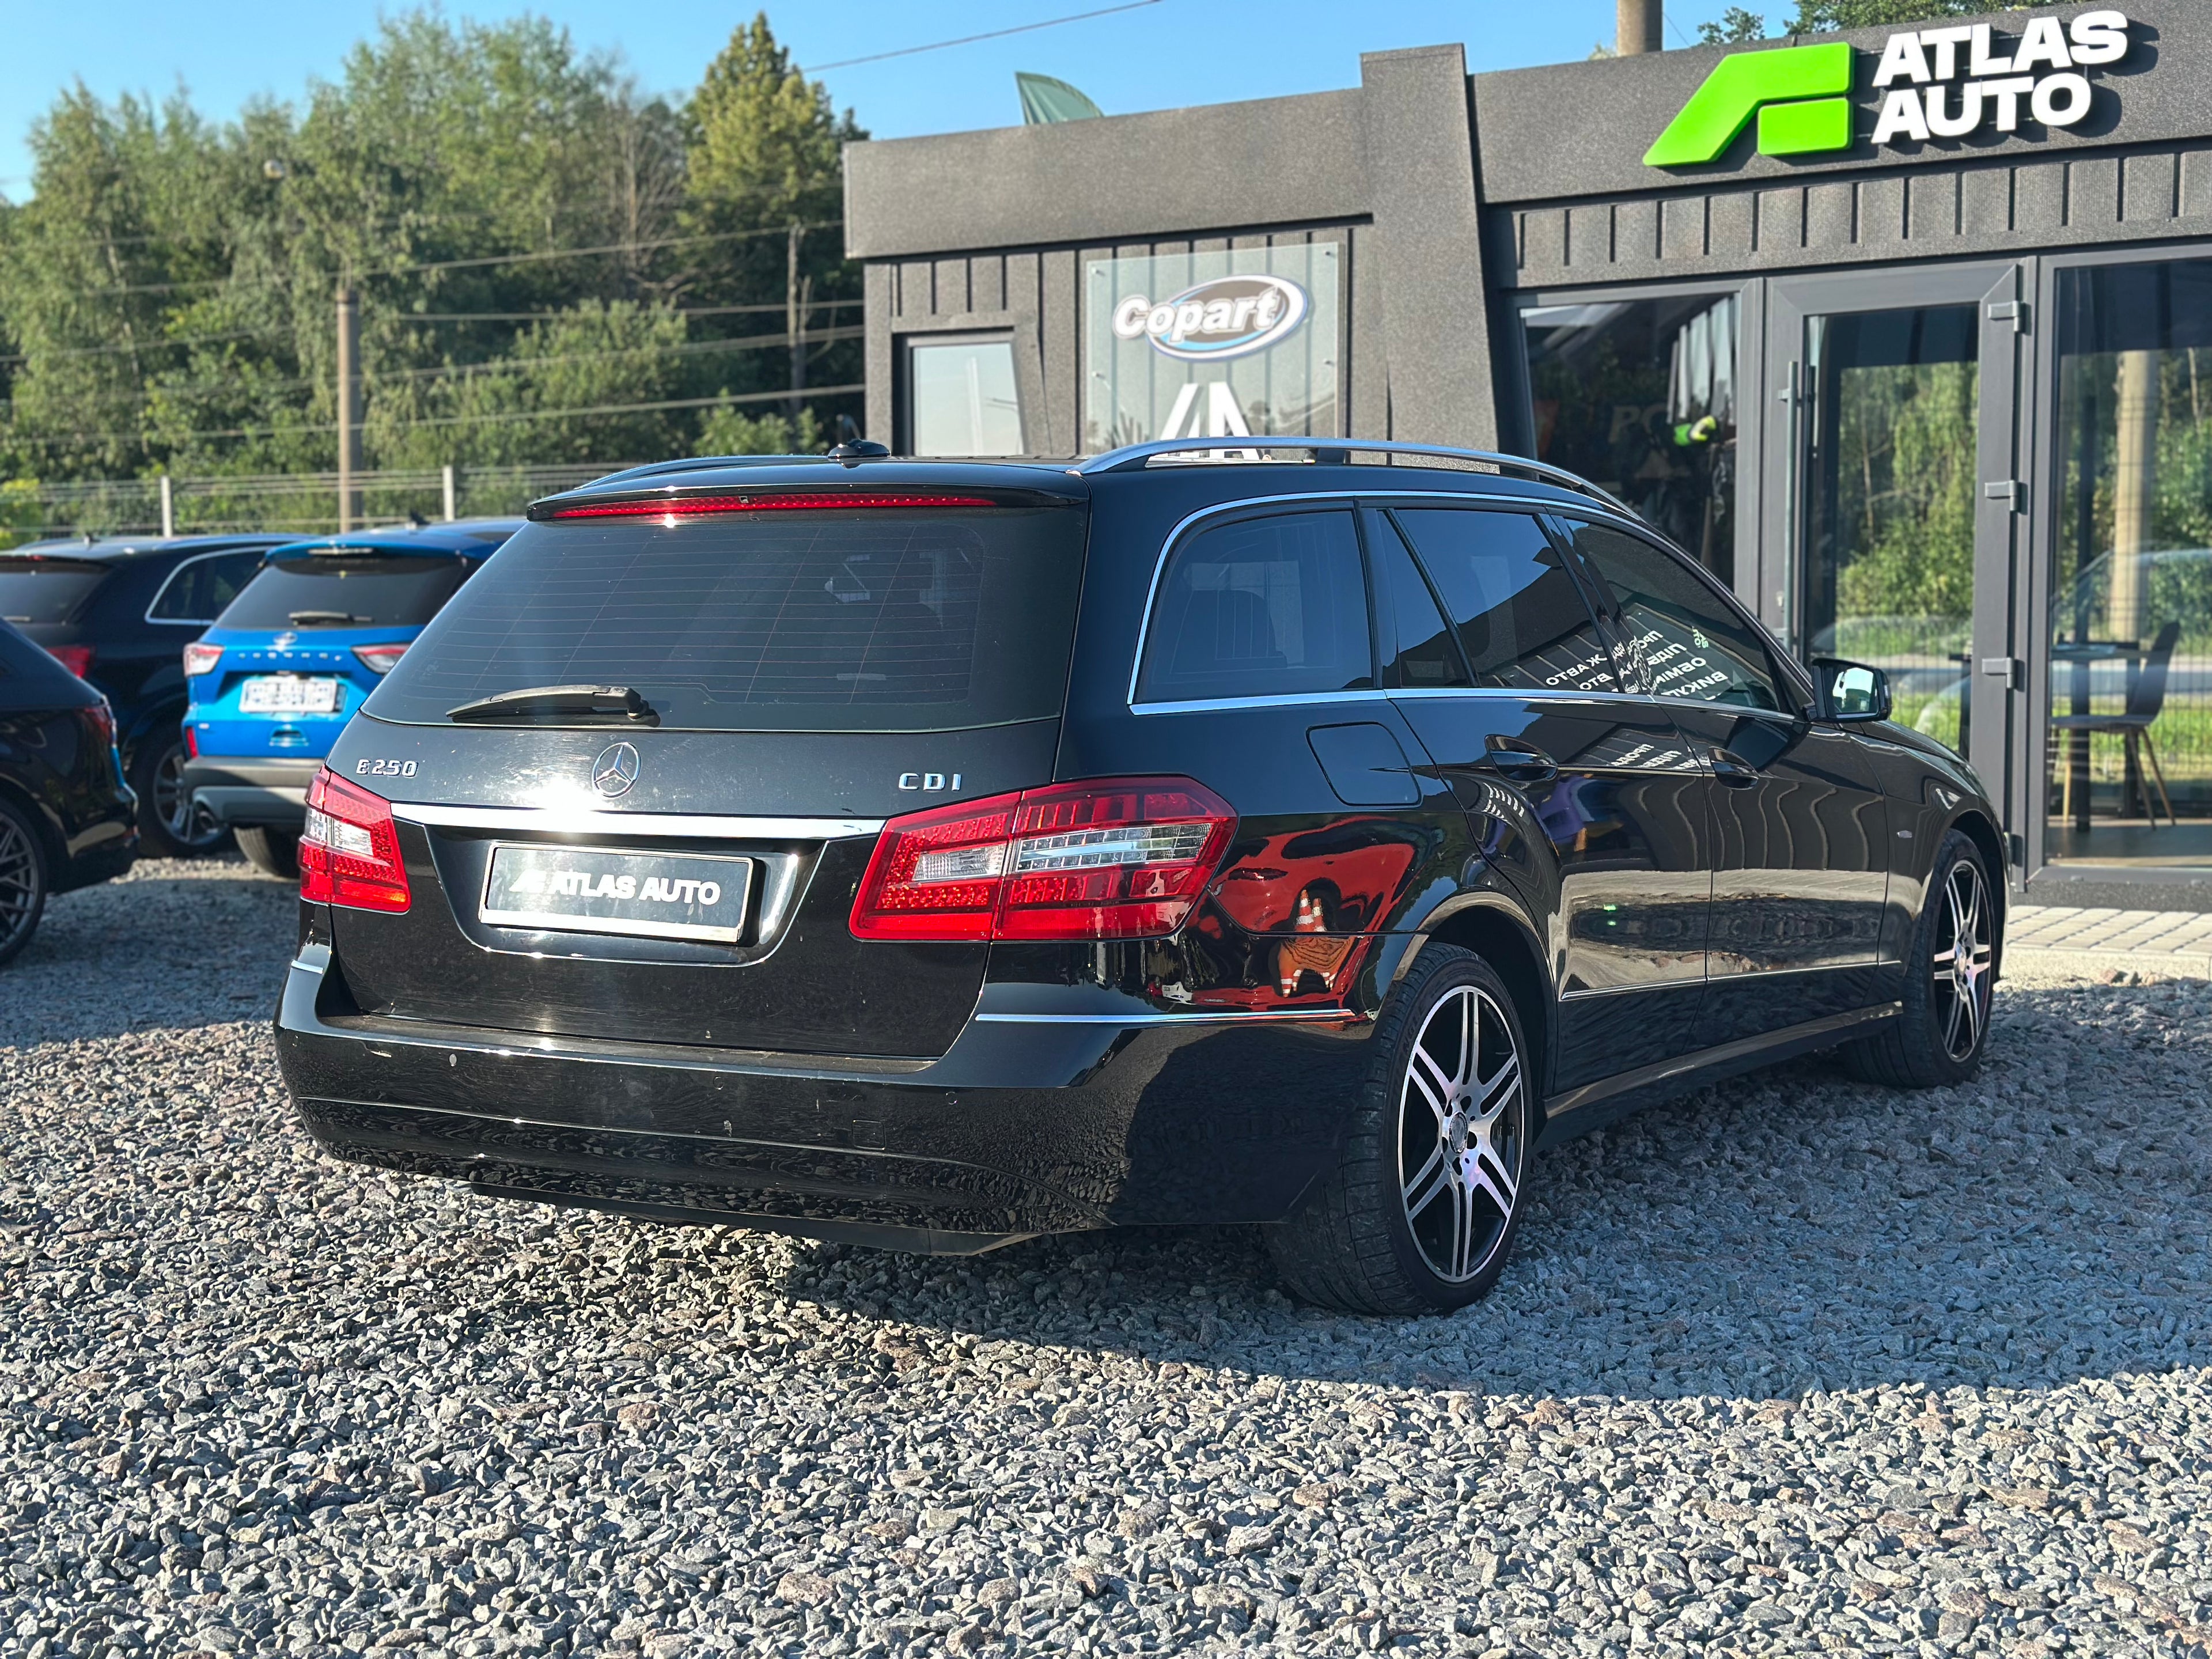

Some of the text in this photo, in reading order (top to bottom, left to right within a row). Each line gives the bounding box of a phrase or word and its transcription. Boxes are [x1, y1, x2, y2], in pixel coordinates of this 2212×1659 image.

[1872, 10, 2128, 87] ATLAS
[1871, 73, 2092, 144] AUTO
[1113, 286, 1281, 346] Copart
[899, 772, 961, 791] CDI
[548, 870, 721, 906] ATLAS AUTO
